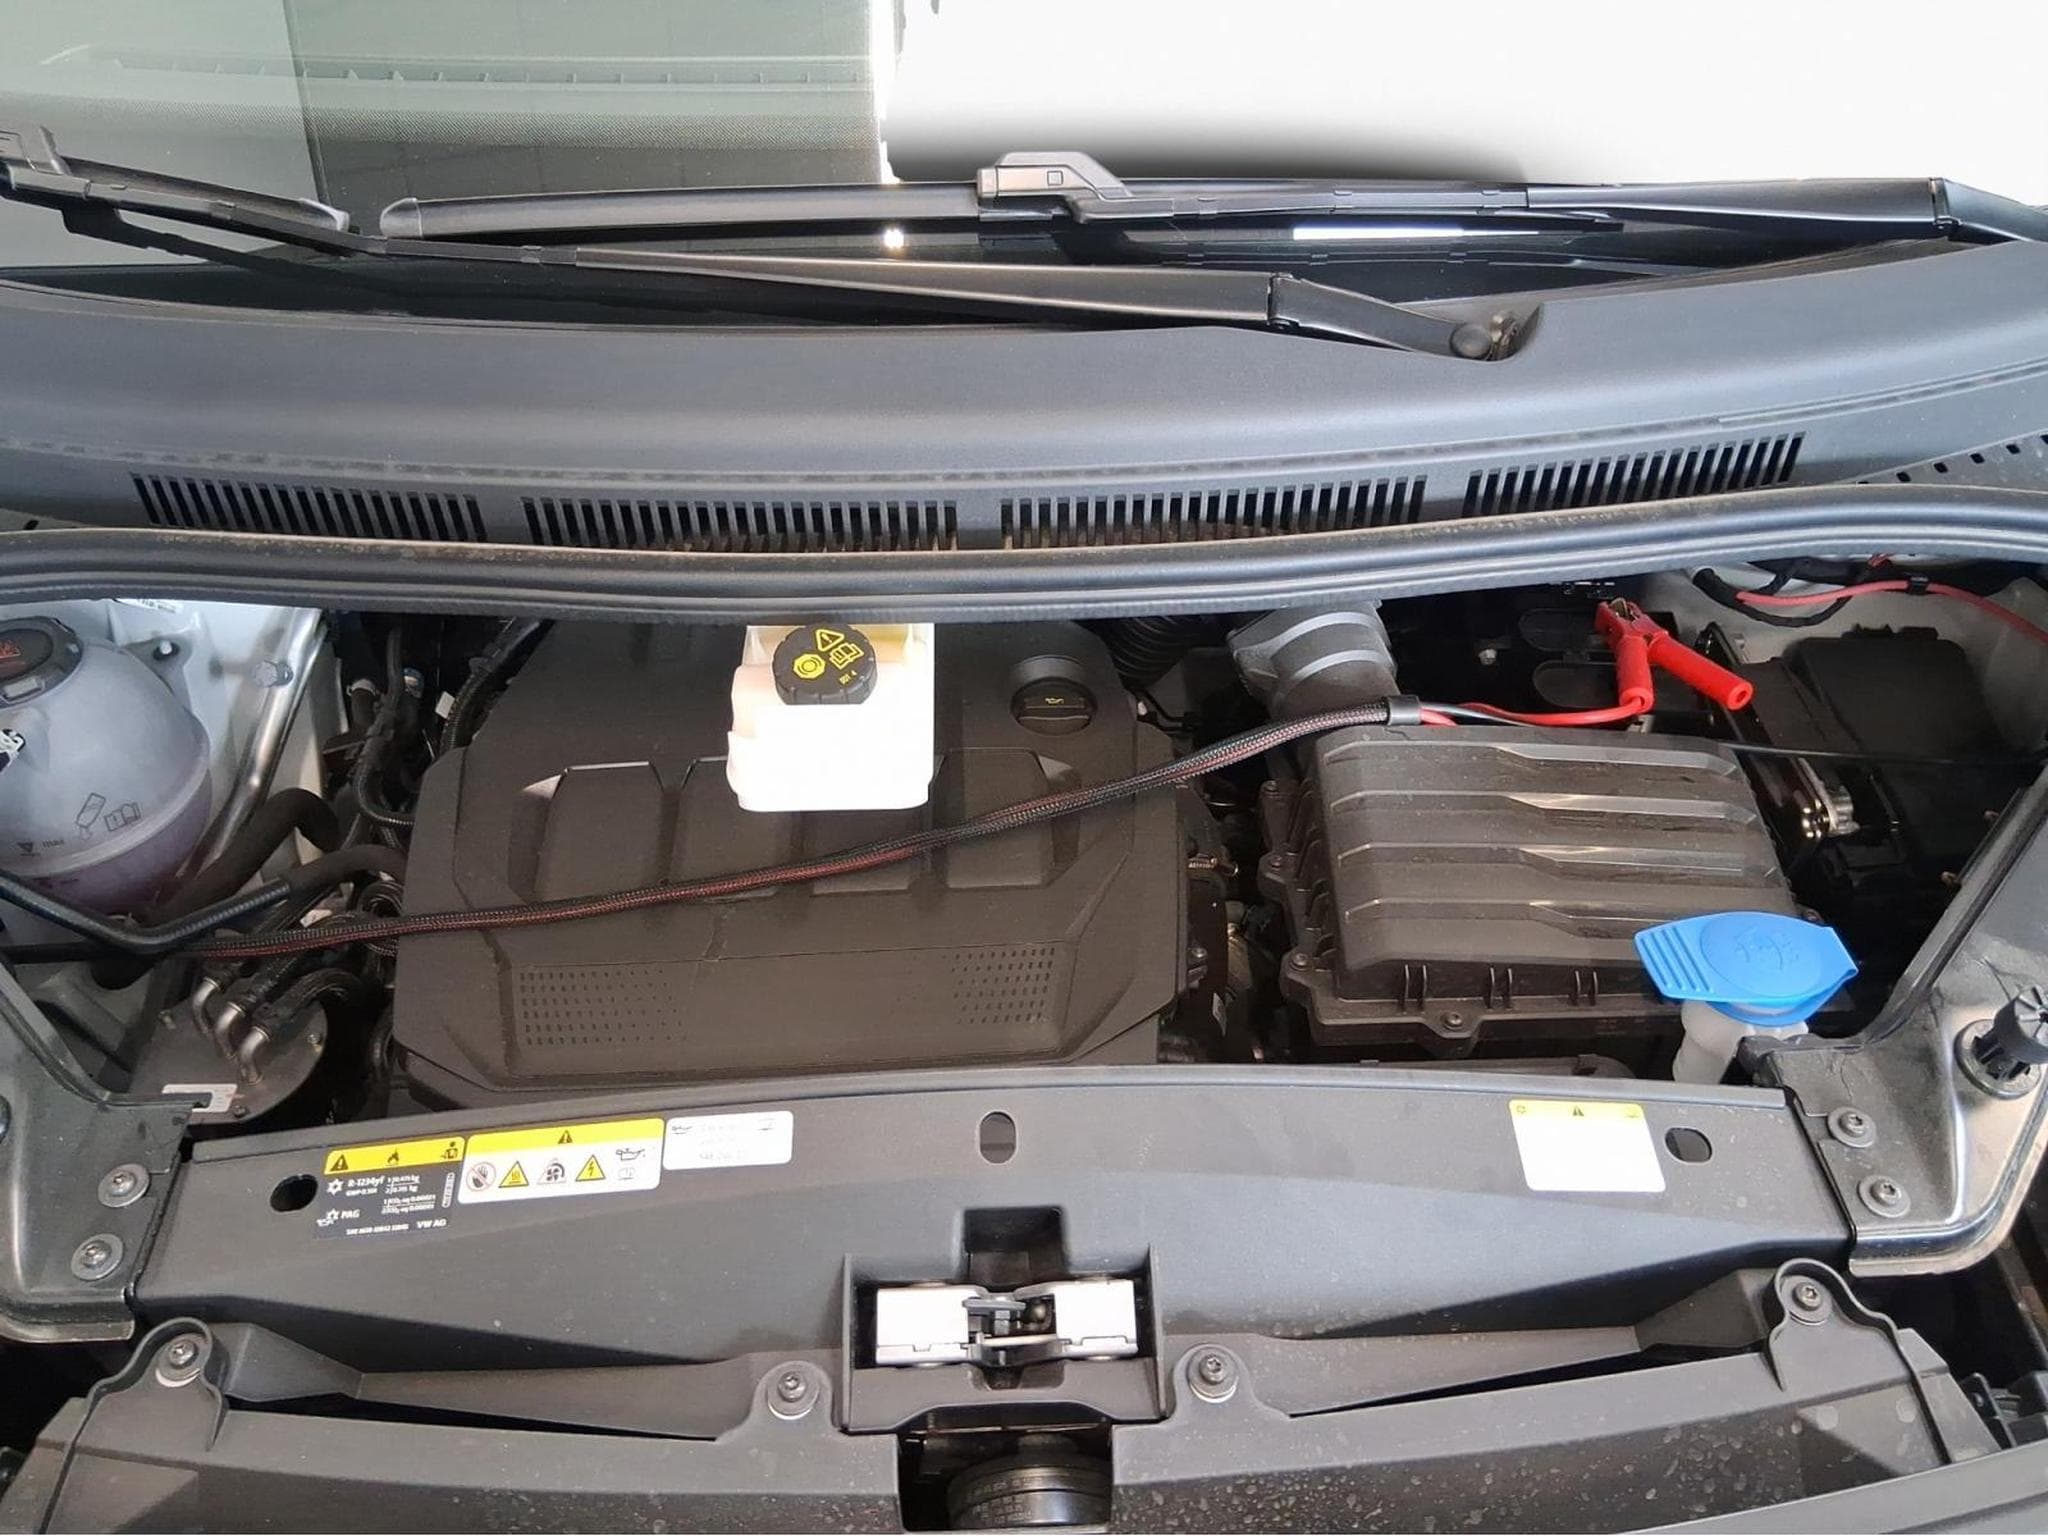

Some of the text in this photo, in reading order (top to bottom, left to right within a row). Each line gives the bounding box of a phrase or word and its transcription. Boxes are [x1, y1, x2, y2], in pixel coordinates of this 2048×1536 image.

[341, 1209, 360, 1219] PAG
[416, 1220, 432, 1229] VW
[433, 1219, 447, 1228] AG
